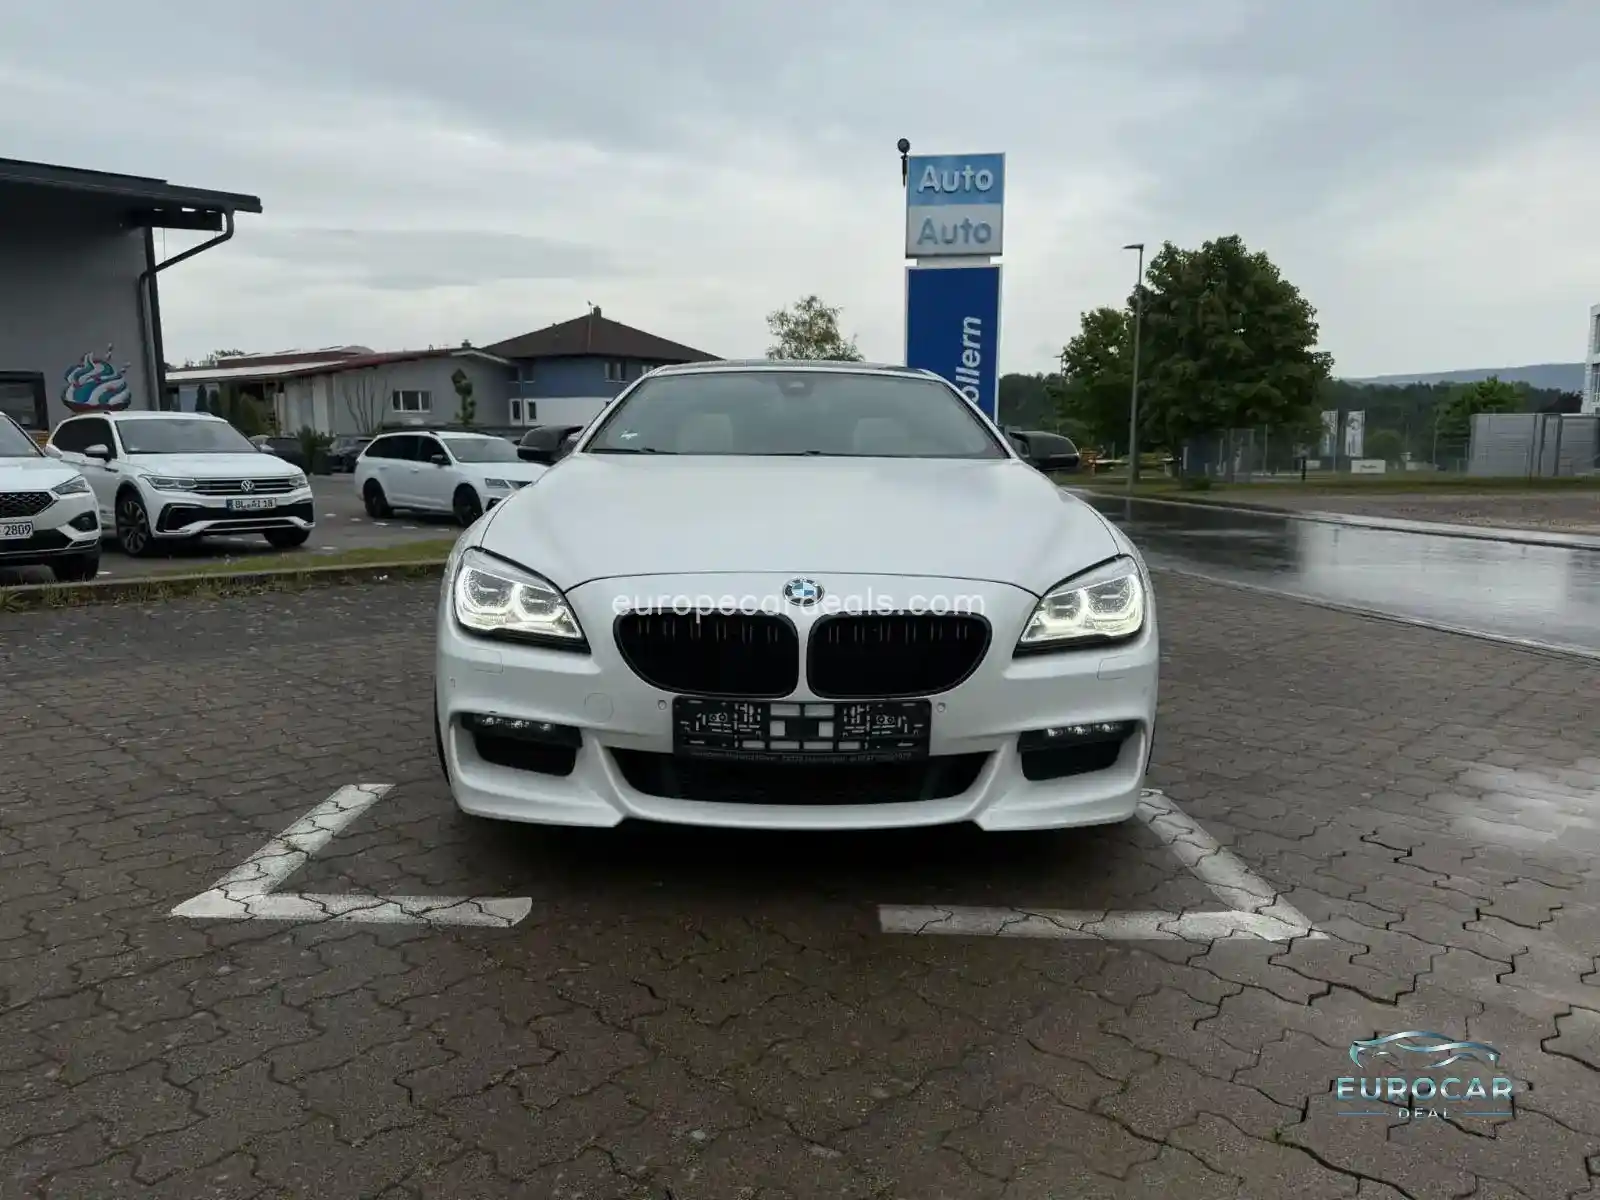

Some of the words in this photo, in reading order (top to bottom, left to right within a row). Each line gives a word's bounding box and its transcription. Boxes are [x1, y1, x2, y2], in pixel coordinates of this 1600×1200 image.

[917, 165, 994, 194] Auto
[916, 215, 992, 246] Auto
[4, 524, 31, 536] 2809
